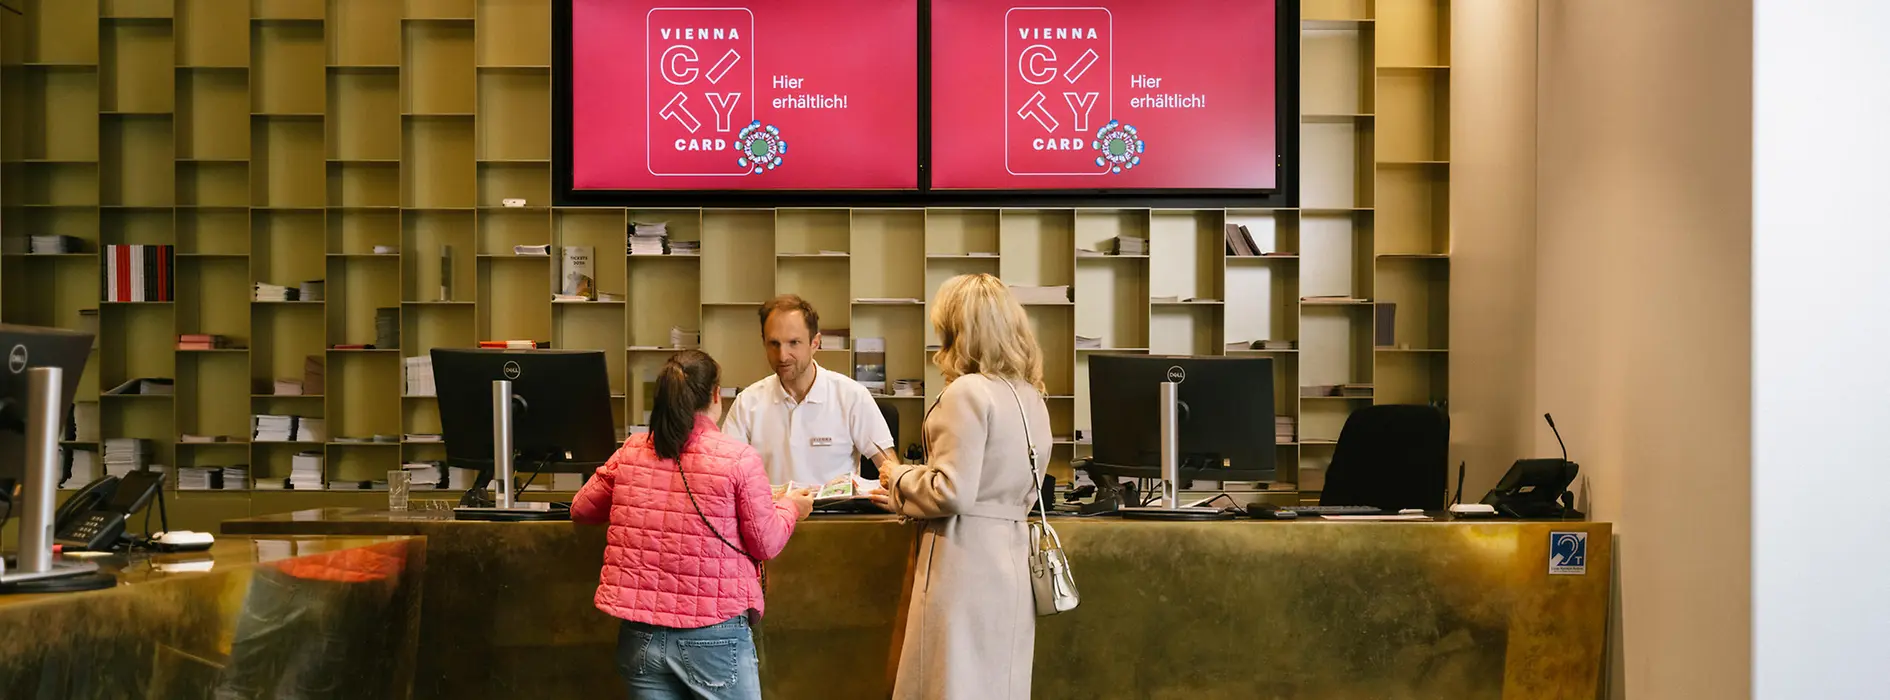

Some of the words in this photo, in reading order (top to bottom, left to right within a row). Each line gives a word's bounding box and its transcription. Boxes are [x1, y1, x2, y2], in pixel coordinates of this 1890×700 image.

[660, 28, 740, 40] VIENNA
[1019, 27, 1098, 40] VIENNA
[772, 75, 804, 89] Hier
[1130, 74, 1162, 88] Hier
[772, 94, 848, 109] erhältlich!
[1130, 93, 1205, 108] erhältlich!
[674, 138, 726, 151] CARD
[1032, 138, 1084, 151] CARD
[1575, 556, 1582, 564] T
